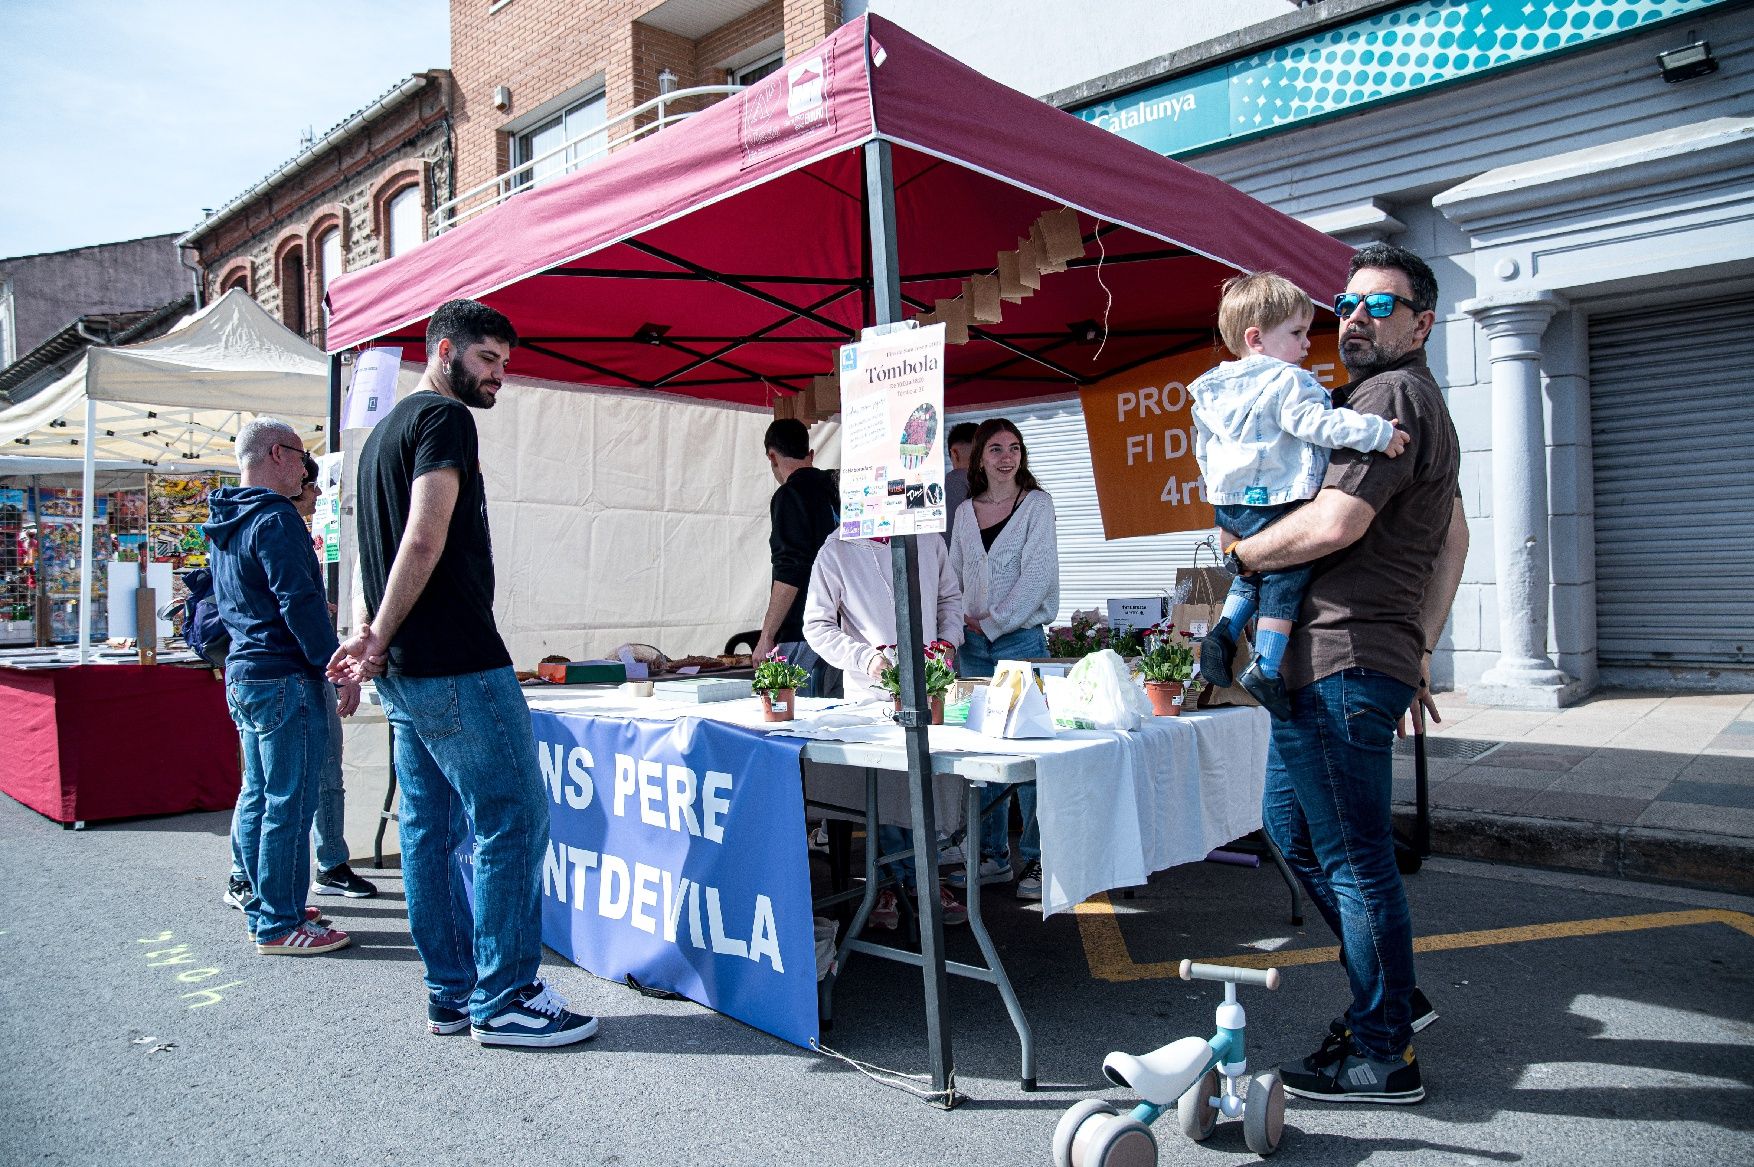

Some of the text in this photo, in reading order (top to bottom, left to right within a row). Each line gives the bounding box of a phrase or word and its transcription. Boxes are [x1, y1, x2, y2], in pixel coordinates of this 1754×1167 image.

[866, 354, 938, 384] Tómbola
[1117, 381, 1194, 422] PRO
[1126, 433, 1153, 466] FI
[613, 753, 733, 844] PERE
